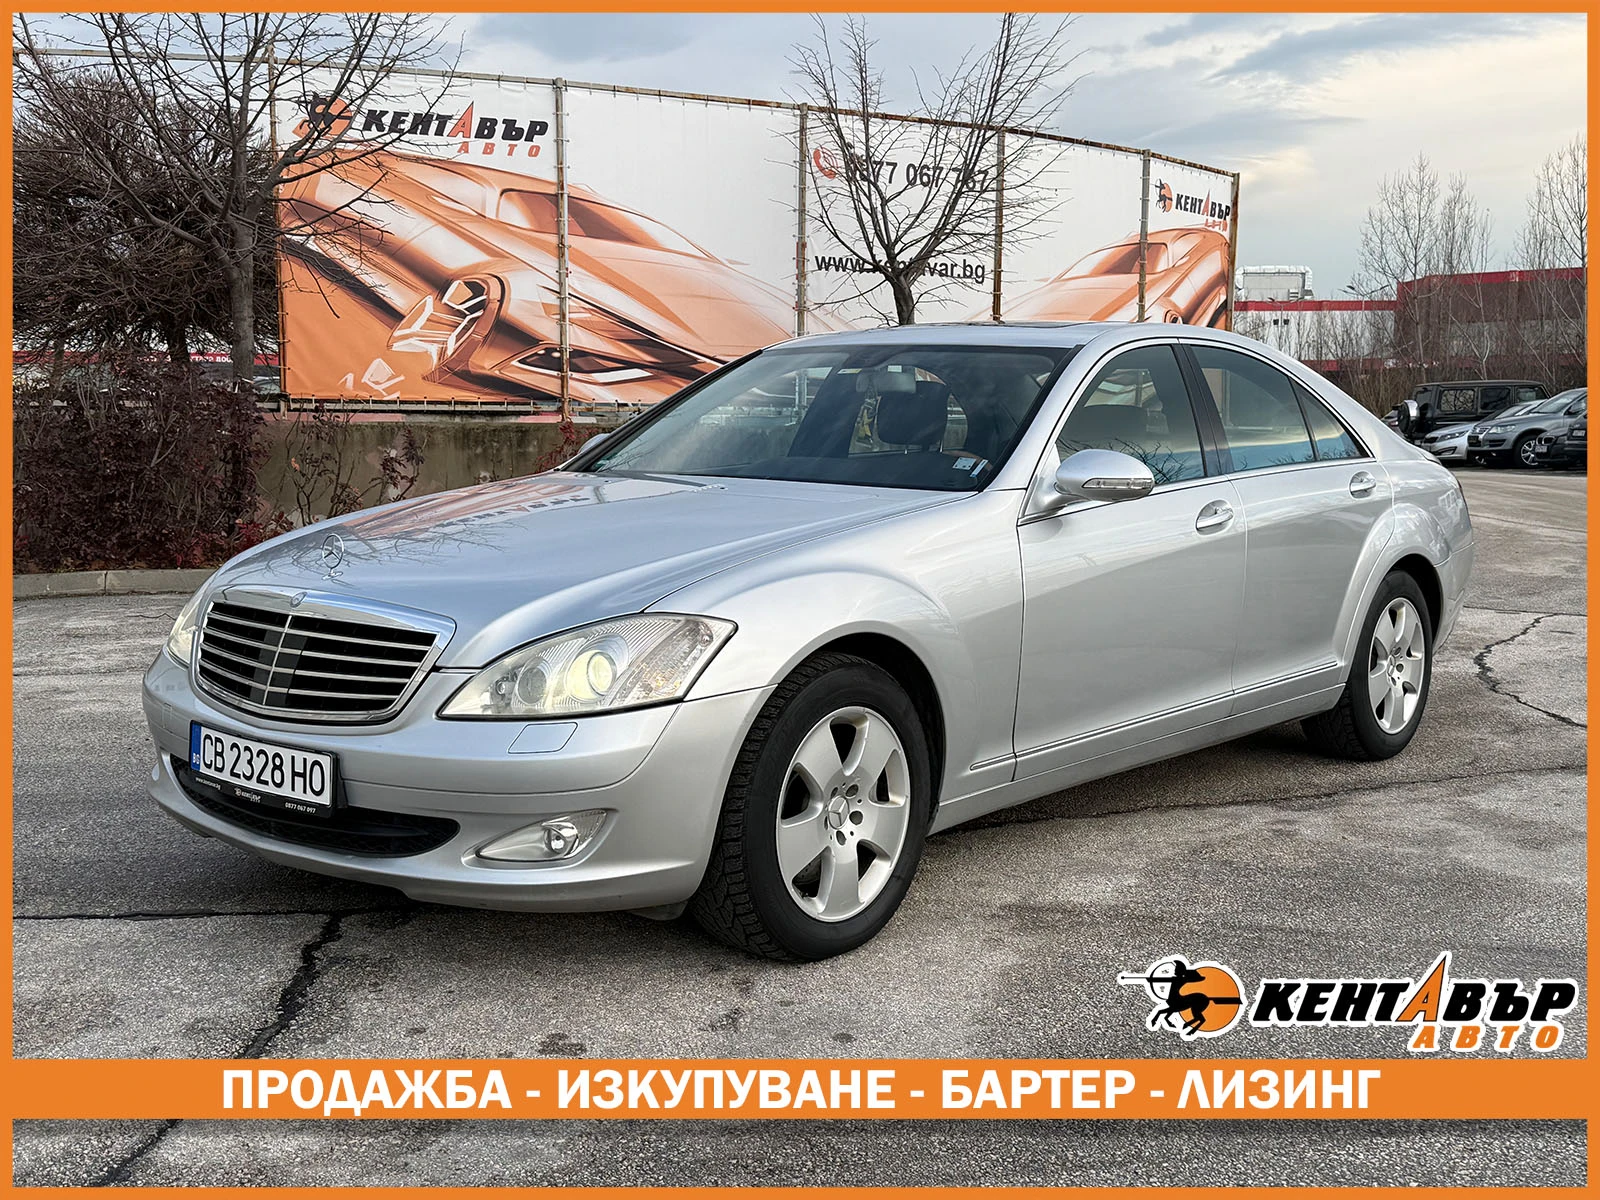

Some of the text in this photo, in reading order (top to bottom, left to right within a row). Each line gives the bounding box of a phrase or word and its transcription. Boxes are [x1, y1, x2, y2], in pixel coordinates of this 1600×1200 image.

[362, 101, 549, 142] КЕНТАВЪР
[457, 141, 541, 158] АВТО
[848, 158, 898, 184] 877
[905, 163, 943, 188] 067
[1175, 188, 1231, 221] КЕНТАВЪР
[815, 255, 986, 284] www.kenvar.bg
[192, 752, 201, 765] BG
[203, 733, 325, 797] CB 2328 HO
